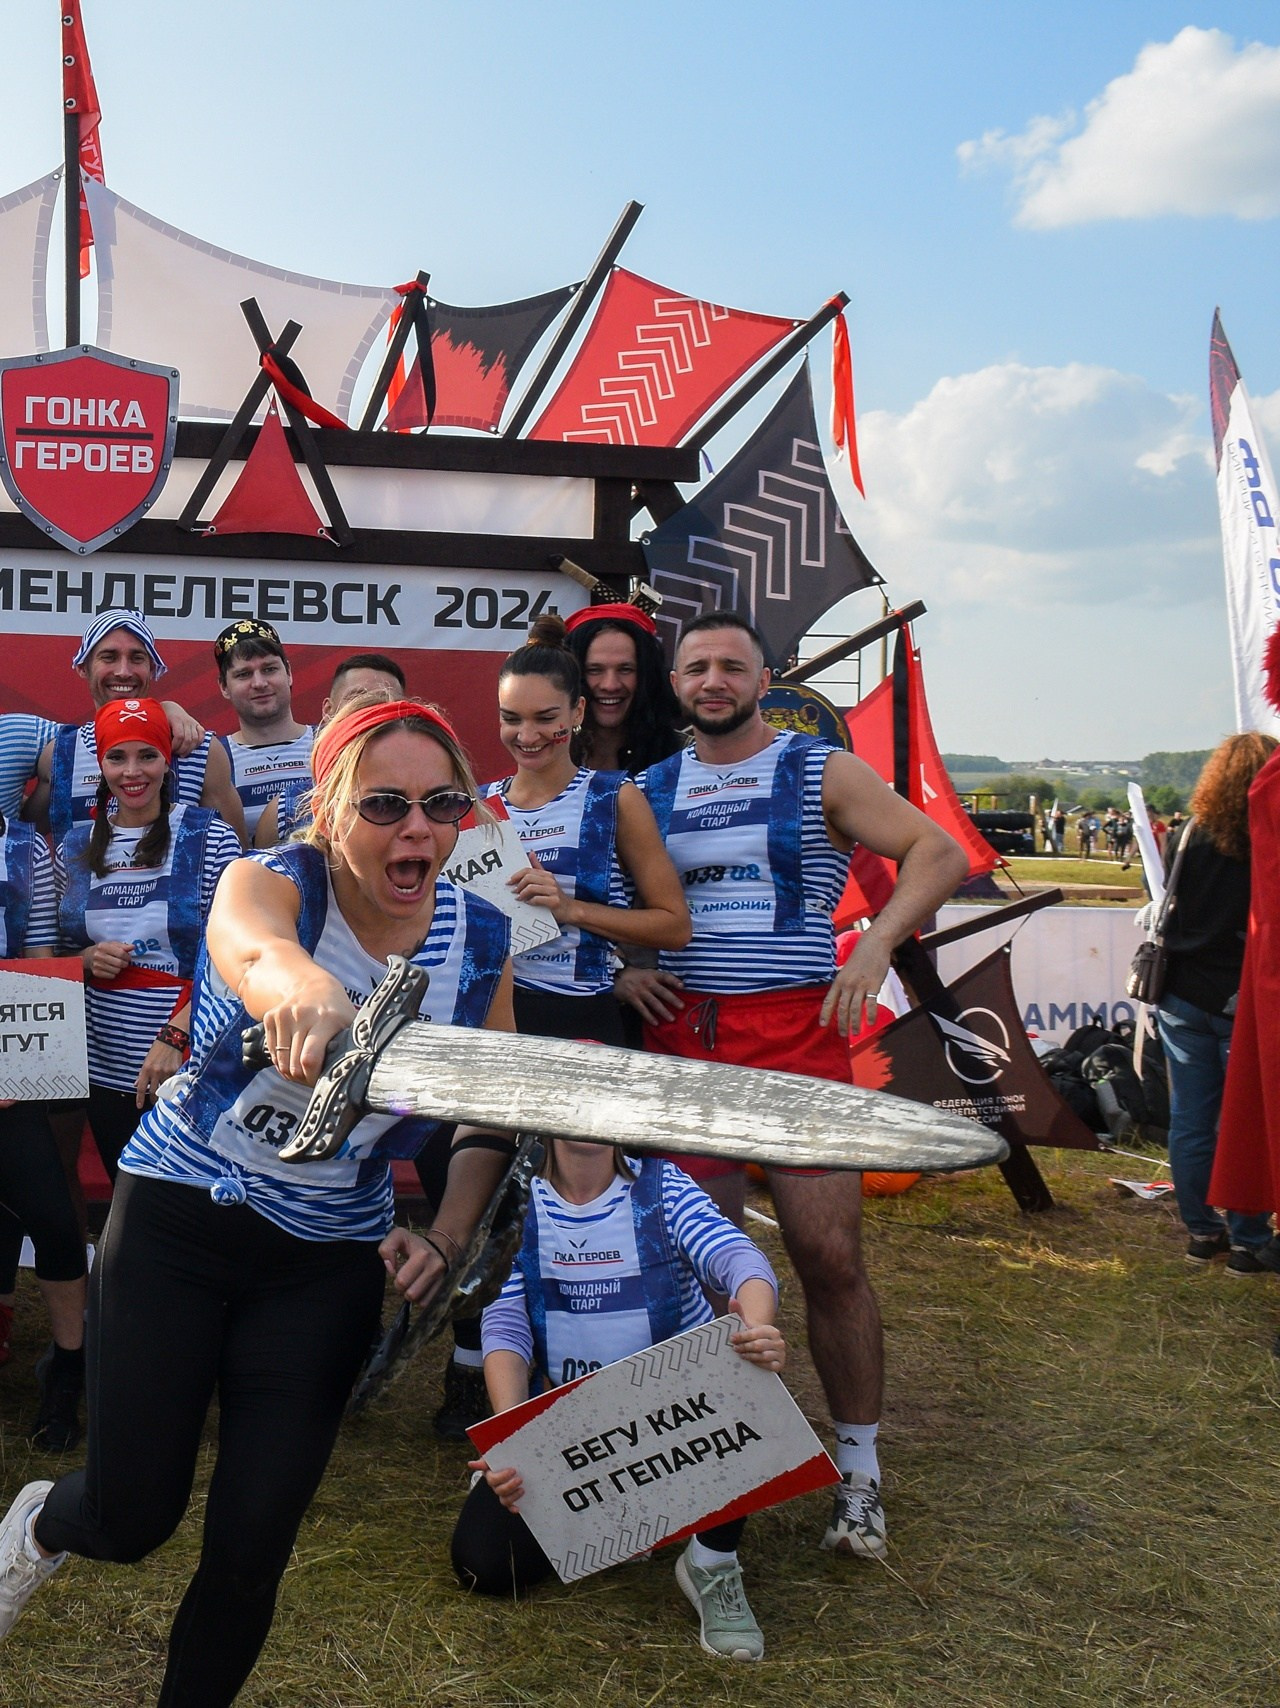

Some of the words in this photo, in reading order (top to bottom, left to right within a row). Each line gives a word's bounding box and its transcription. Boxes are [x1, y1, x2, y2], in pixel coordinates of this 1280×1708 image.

[25, 395, 147, 429] ГОНКА
[15, 441, 155, 474] ГЕРОЕВ
[434, 586, 559, 630] 2024
[244, 764, 272, 774] ГОНКА
[273, 760, 305, 769] ГЕРОЕВ
[688, 785, 718, 796] ГОНКА
[721, 777, 758, 788] ГЕРОЕВ
[687, 800, 750, 820] КОМАНДНЫЙ
[700, 815, 732, 828] СТАРТ
[529, 825, 565, 838] ГЕРОЕВ
[101, 880, 157, 896] КОМАНДНЫЙ
[117, 895, 145, 906] СТАРТ
[701, 899, 771, 914] АММОНИЙ
[132, 938, 162, 956] 02
[932, 1097, 993, 1108] ФЕДЕРАЦИЯ
[996, 1094, 1025, 1104] ГОНОК
[242, 1104, 300, 1146] 03
[578, 1250, 621, 1261] ГЕРОЕВ
[571, 1297, 602, 1310] СТАРТ
[560, 1421, 639, 1471] БЕГУ
[645, 1392, 717, 1436] КАК
[562, 1480, 604, 1513] ОТ
[608, 1421, 763, 1494] ГЕПАРДА
